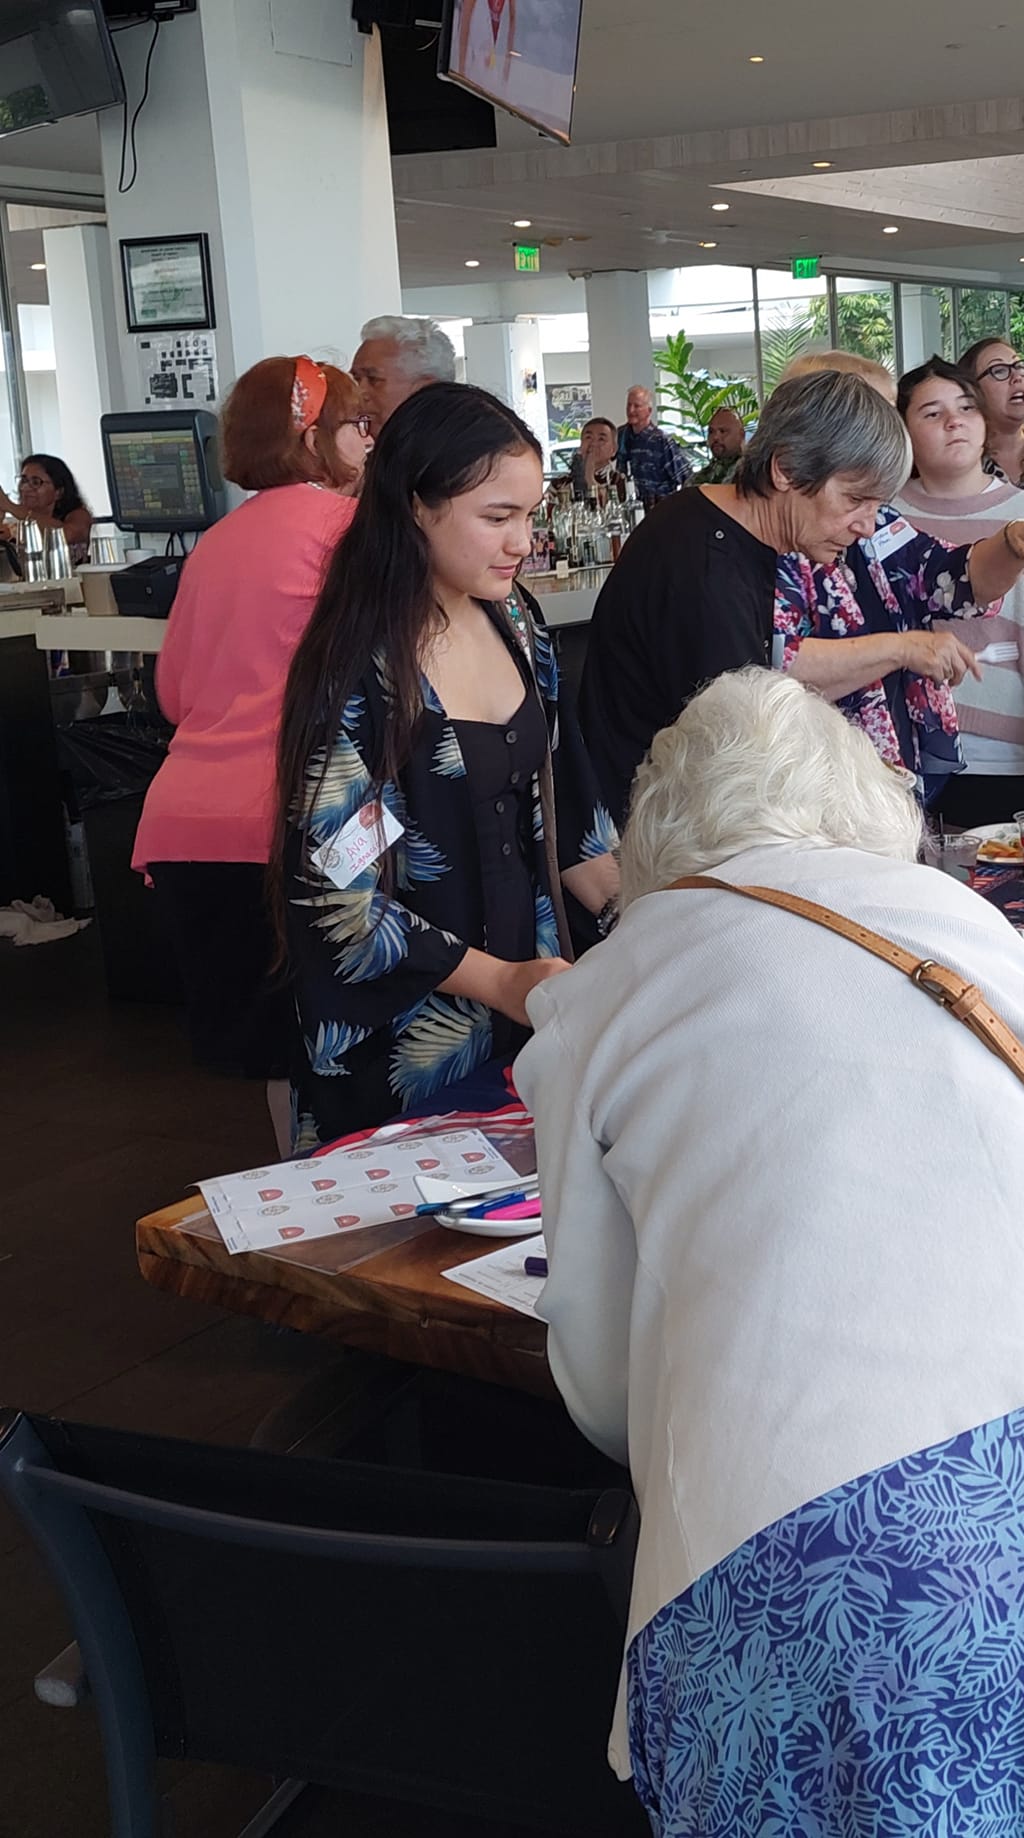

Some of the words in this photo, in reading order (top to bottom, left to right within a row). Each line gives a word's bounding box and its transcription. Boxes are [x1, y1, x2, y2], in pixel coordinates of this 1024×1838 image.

[518, 247, 537, 267] EXIT
[796, 258, 818, 275] EXIT
[346, 837, 367, 861] Ava
